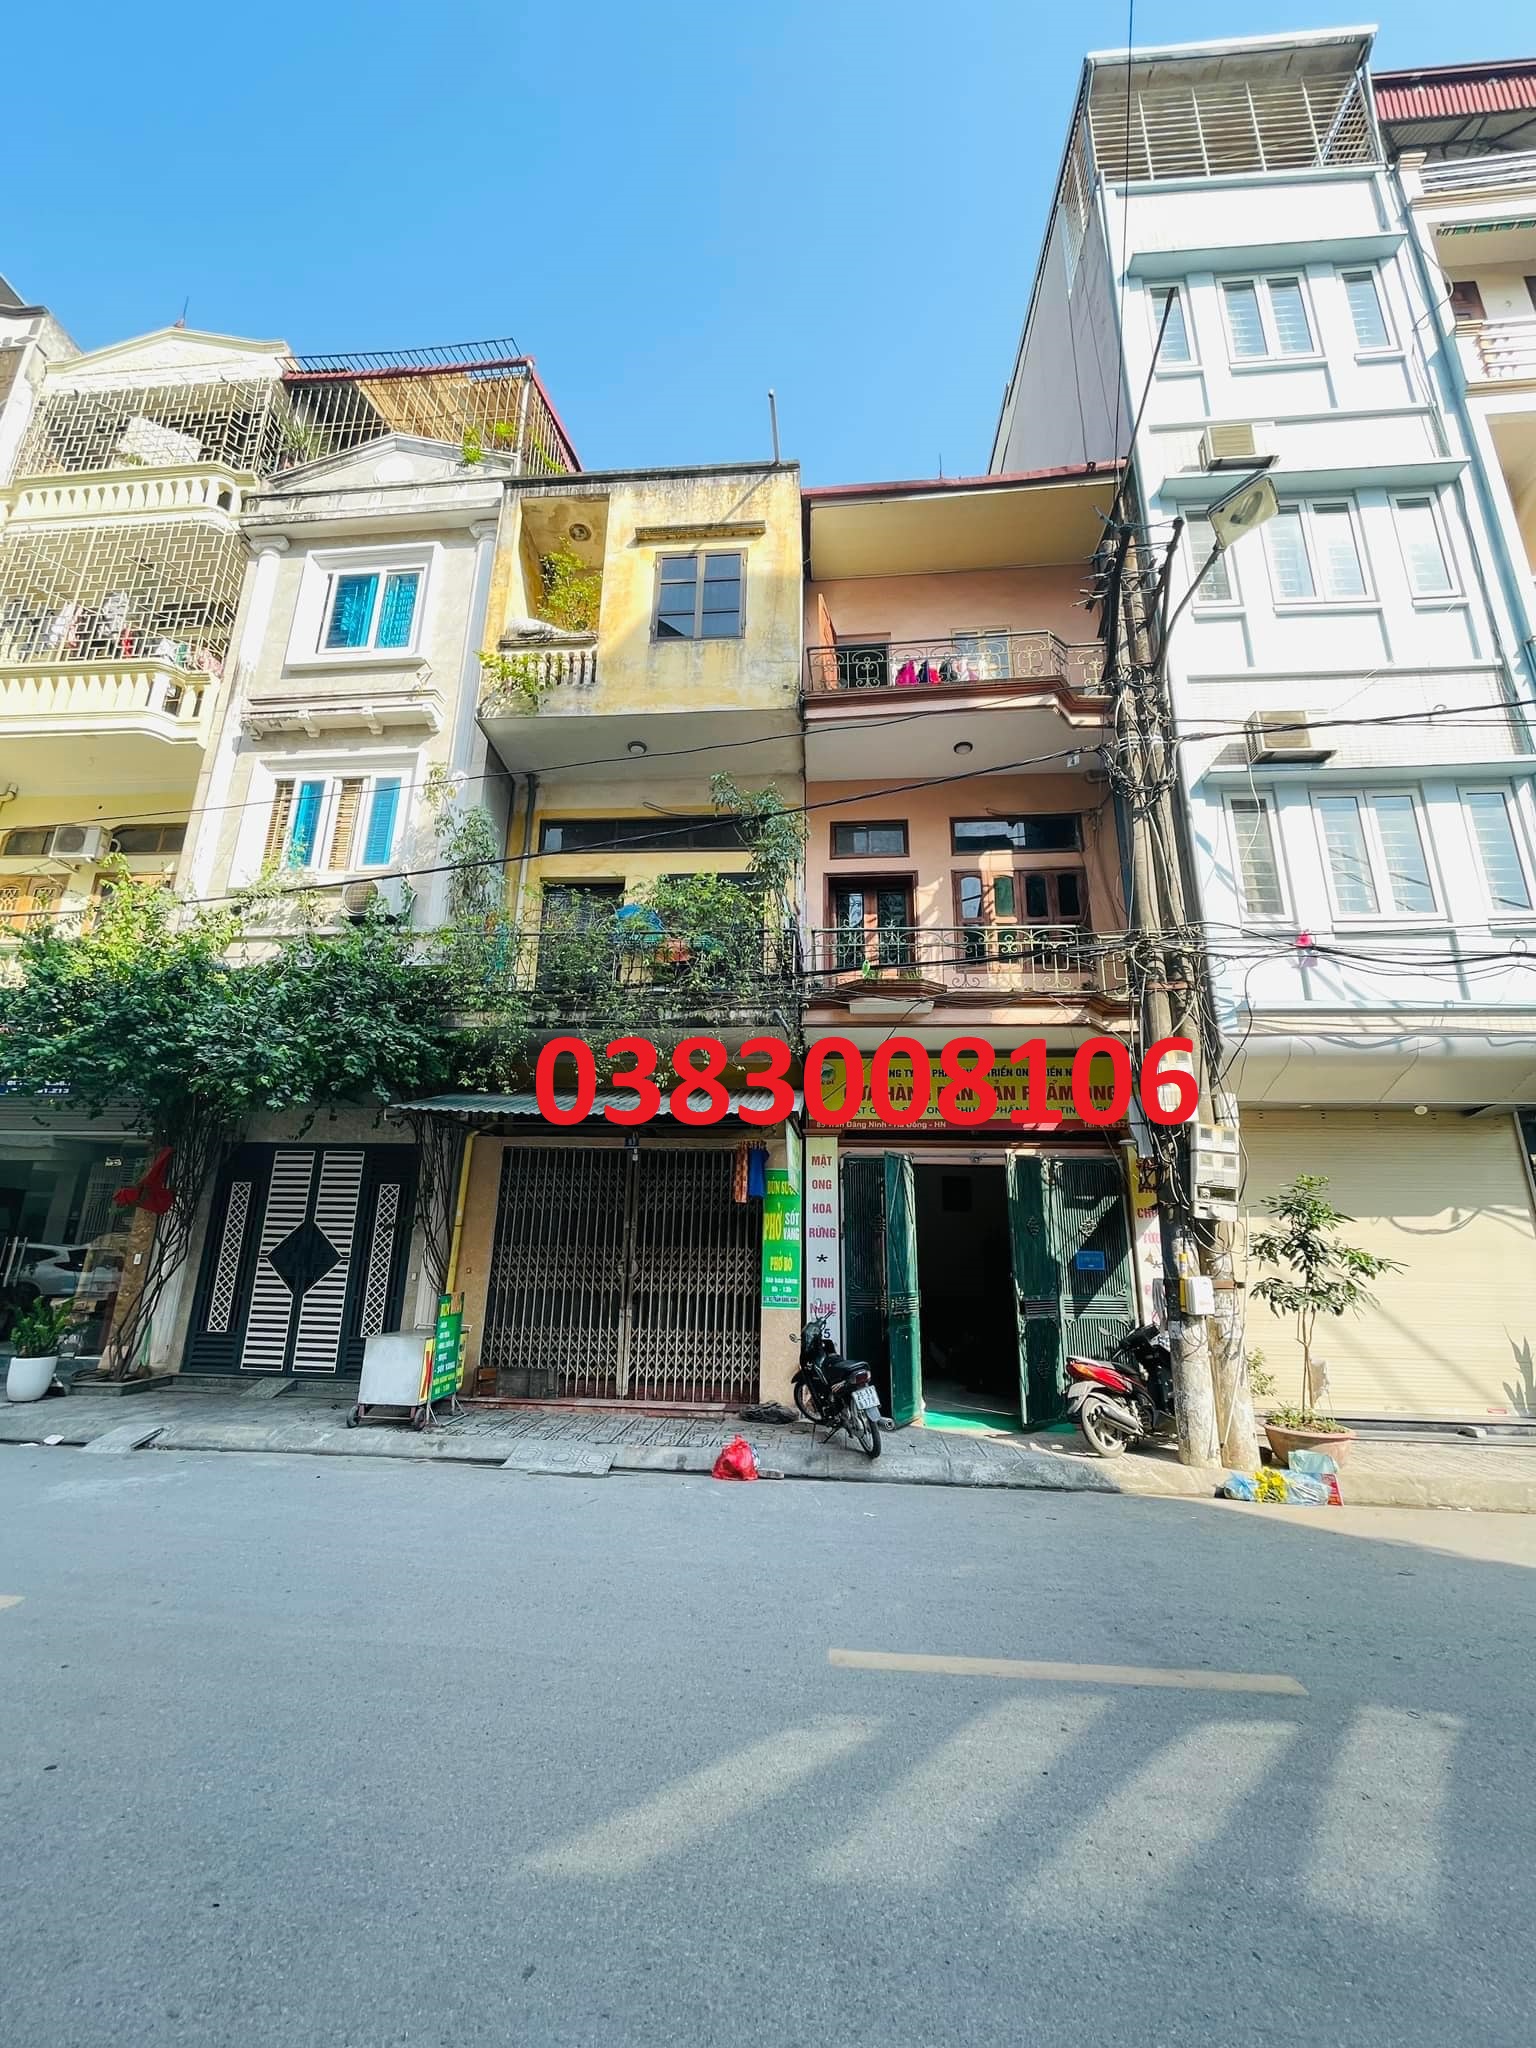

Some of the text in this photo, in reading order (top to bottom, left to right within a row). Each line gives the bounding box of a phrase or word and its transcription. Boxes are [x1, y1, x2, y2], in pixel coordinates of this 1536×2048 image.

[812, 1179, 832, 1190] ONG
[812, 1203, 832, 1214] HOA
[811, 1277, 834, 1289] TINH
